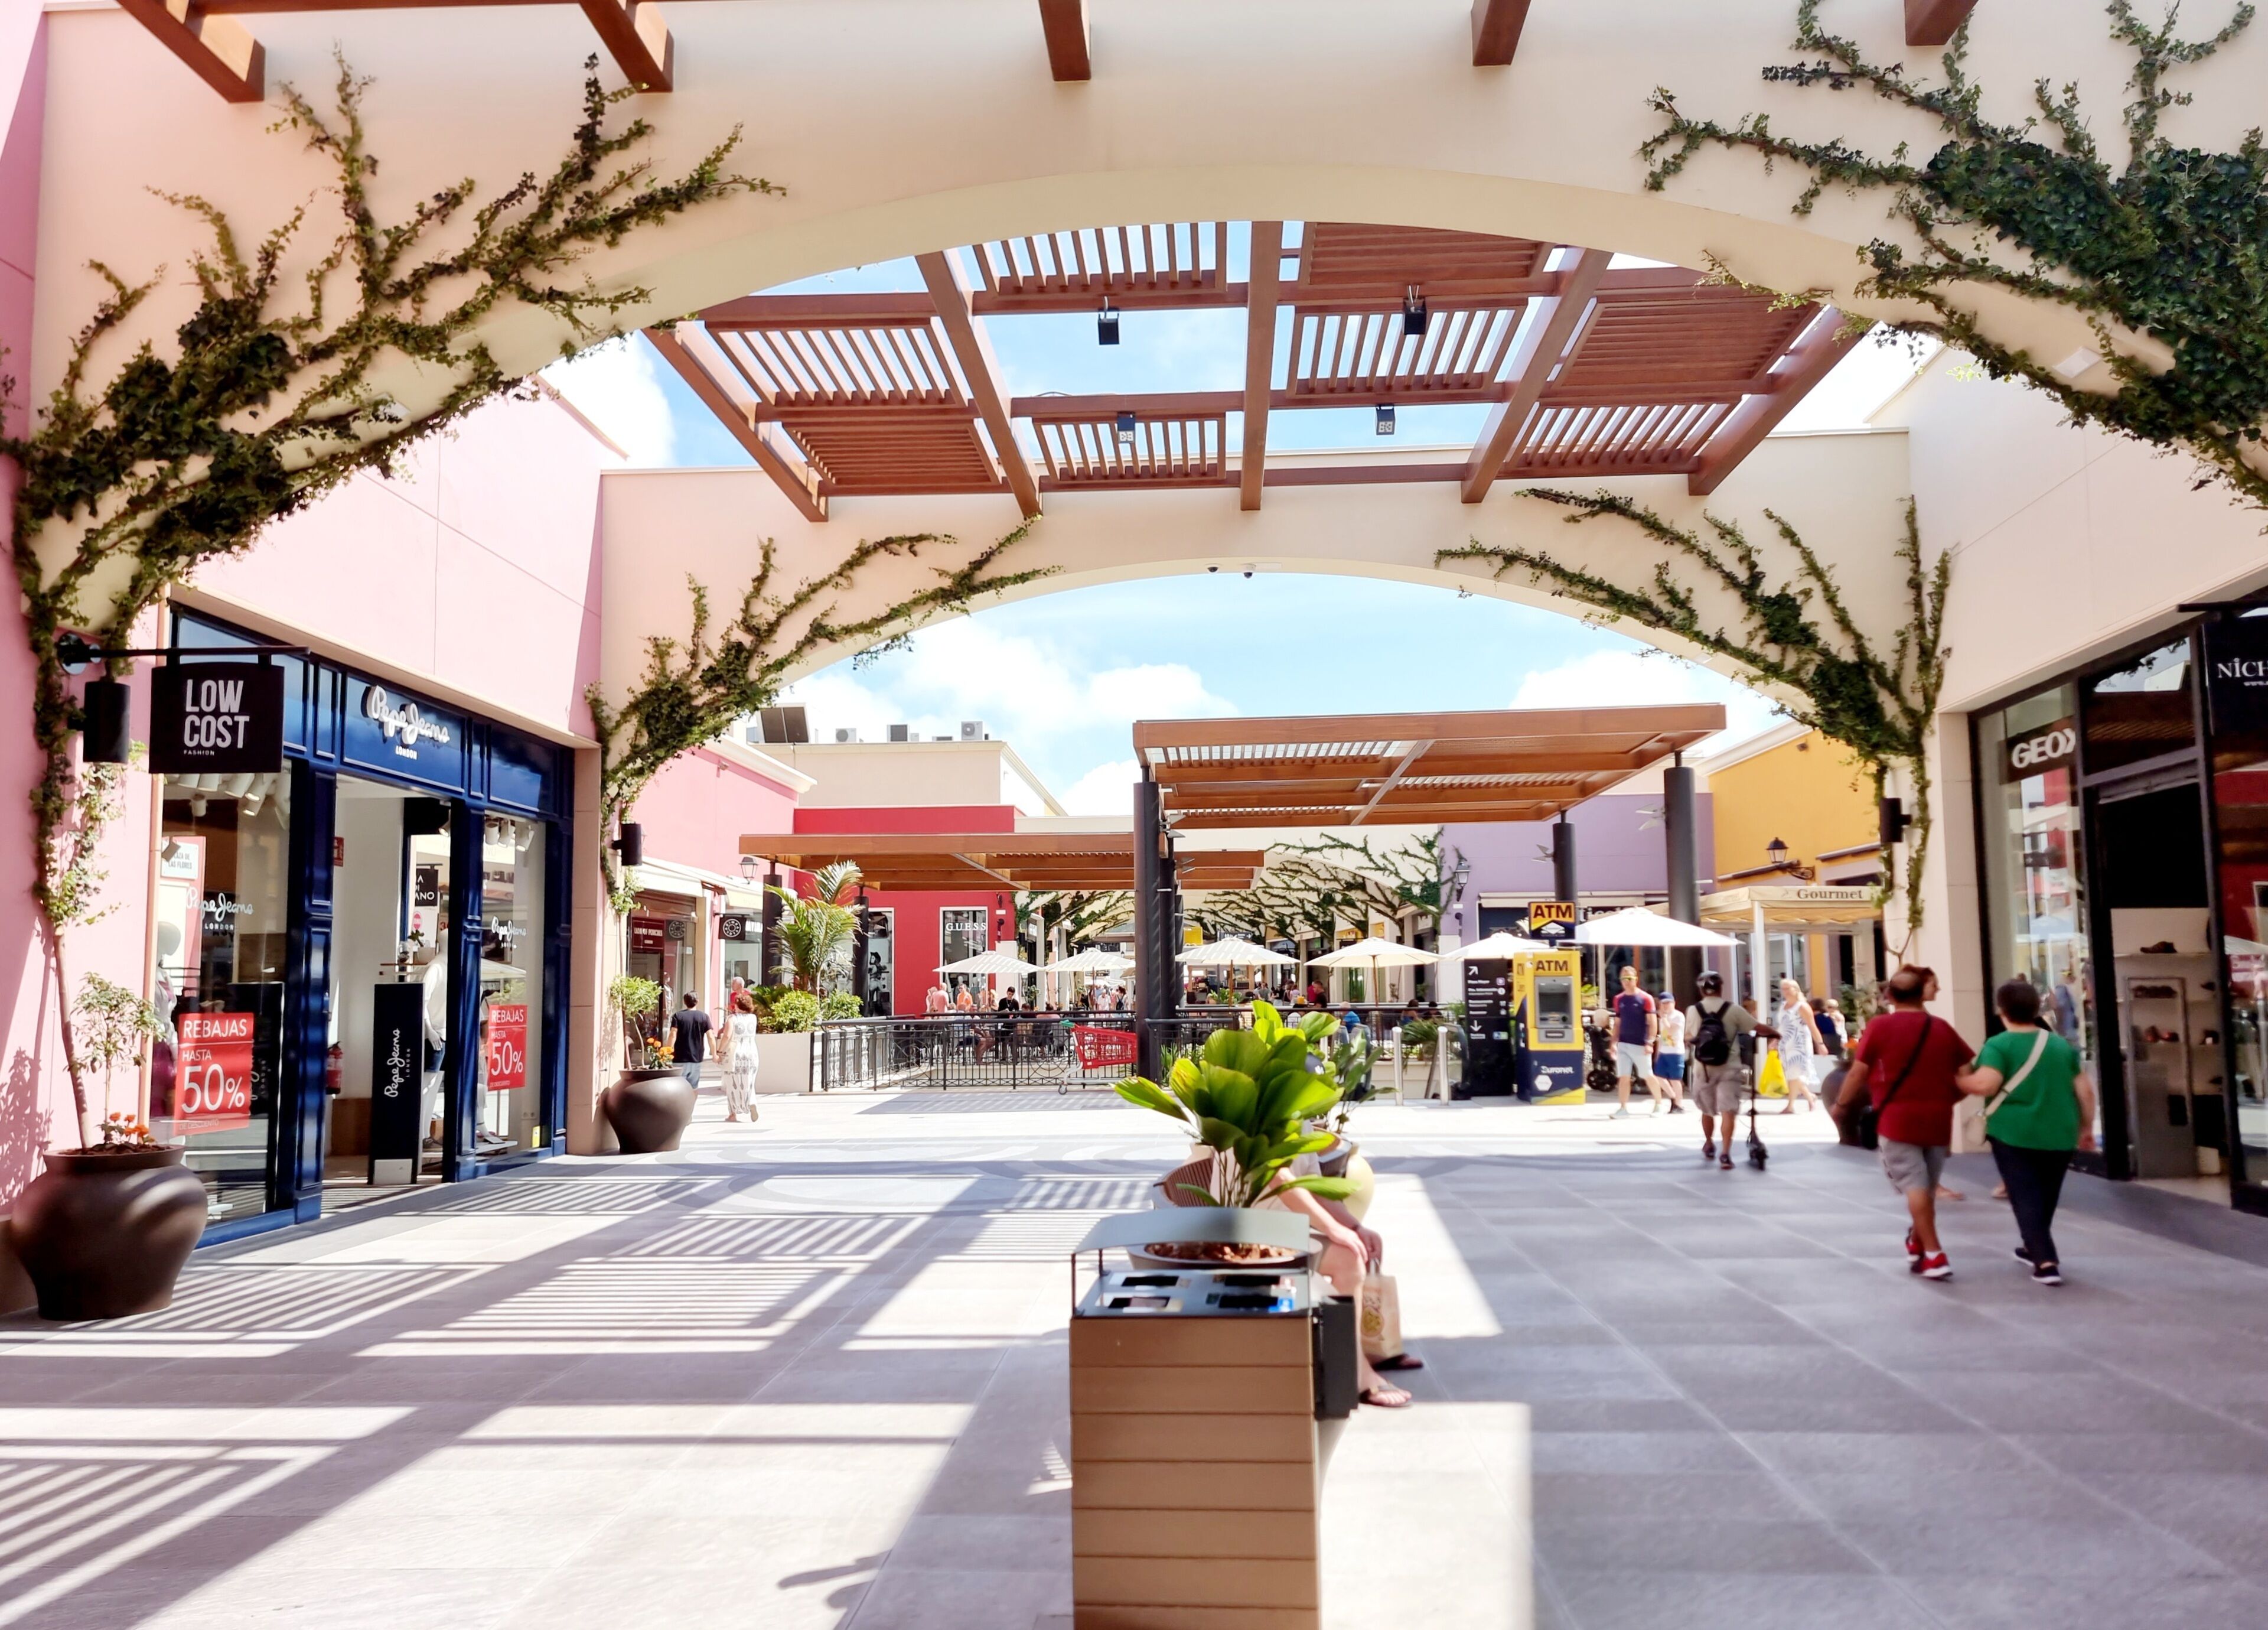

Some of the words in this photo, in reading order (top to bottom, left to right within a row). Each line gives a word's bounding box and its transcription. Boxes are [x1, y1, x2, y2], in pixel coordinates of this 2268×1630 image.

[185, 679, 244, 712] LOW
[367, 685, 408, 737] Pepe
[402, 703, 451, 745] Jeans
[184, 714, 250, 749] COST
[395, 745, 418, 760] LONDON
[177, 861, 193, 870] FLORES
[415, 892, 435, 900] ANO
[1797, 889, 1863, 899] Gourmet
[187, 886, 217, 920] Pepe
[215, 892, 254, 922] Jeans
[1533, 905, 1572, 919] ATM
[204, 922, 234, 931] LONDON
[491, 916, 509, 941] Pepe
[507, 920, 527, 942] Jeans
[946, 922, 986, 931] GUESS
[1536, 960, 1569, 971] ATM
[491, 1008, 524, 1023] REBAJAS
[183, 1019, 247, 1039] REBAJAS
[491, 1030, 506, 1039] HASTA
[387, 1028, 405, 1067] Jeans
[182, 1049, 212, 1062] HASTA
[491, 1040, 523, 1076] 50%
[181, 1063, 245, 1114] 50%
[384, 1067, 405, 1098] Pepe
